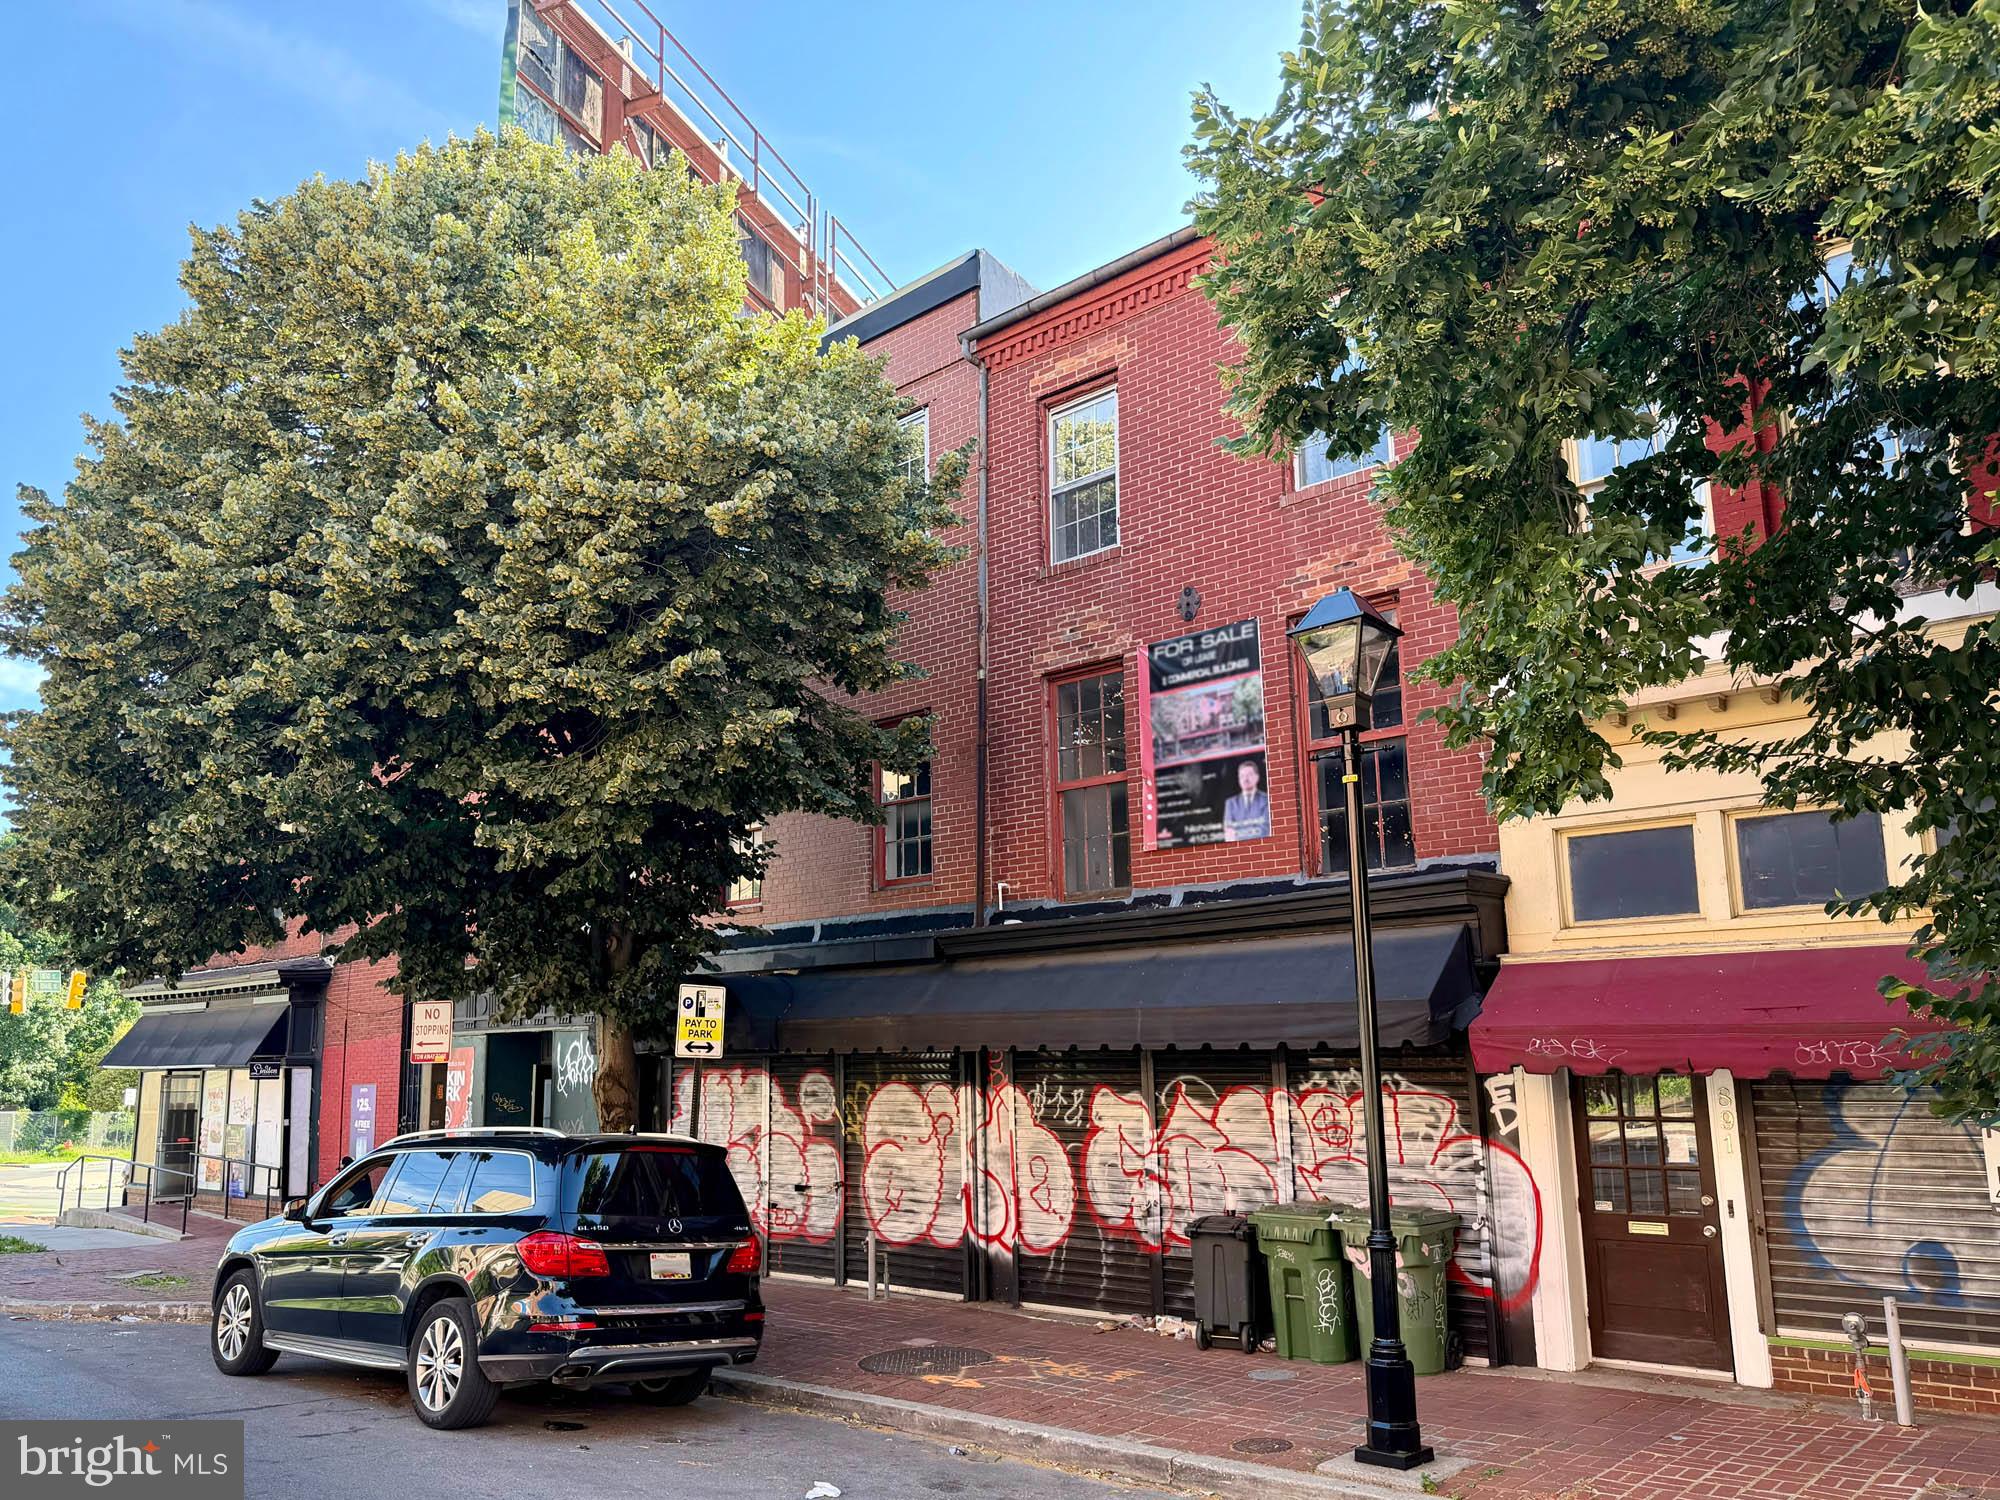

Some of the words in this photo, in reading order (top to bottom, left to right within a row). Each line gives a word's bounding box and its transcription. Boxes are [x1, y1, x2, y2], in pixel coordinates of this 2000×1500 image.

[1153, 638, 1194, 660] FOR
[1200, 623, 1255, 649] SALE
[425, 1008, 440, 1020] NO
[685, 1018, 702, 1028] PAY
[705, 1019, 717, 1028] TO
[415, 1024, 449, 1036] STOPPING
[688, 1029, 713, 1039] PARK
